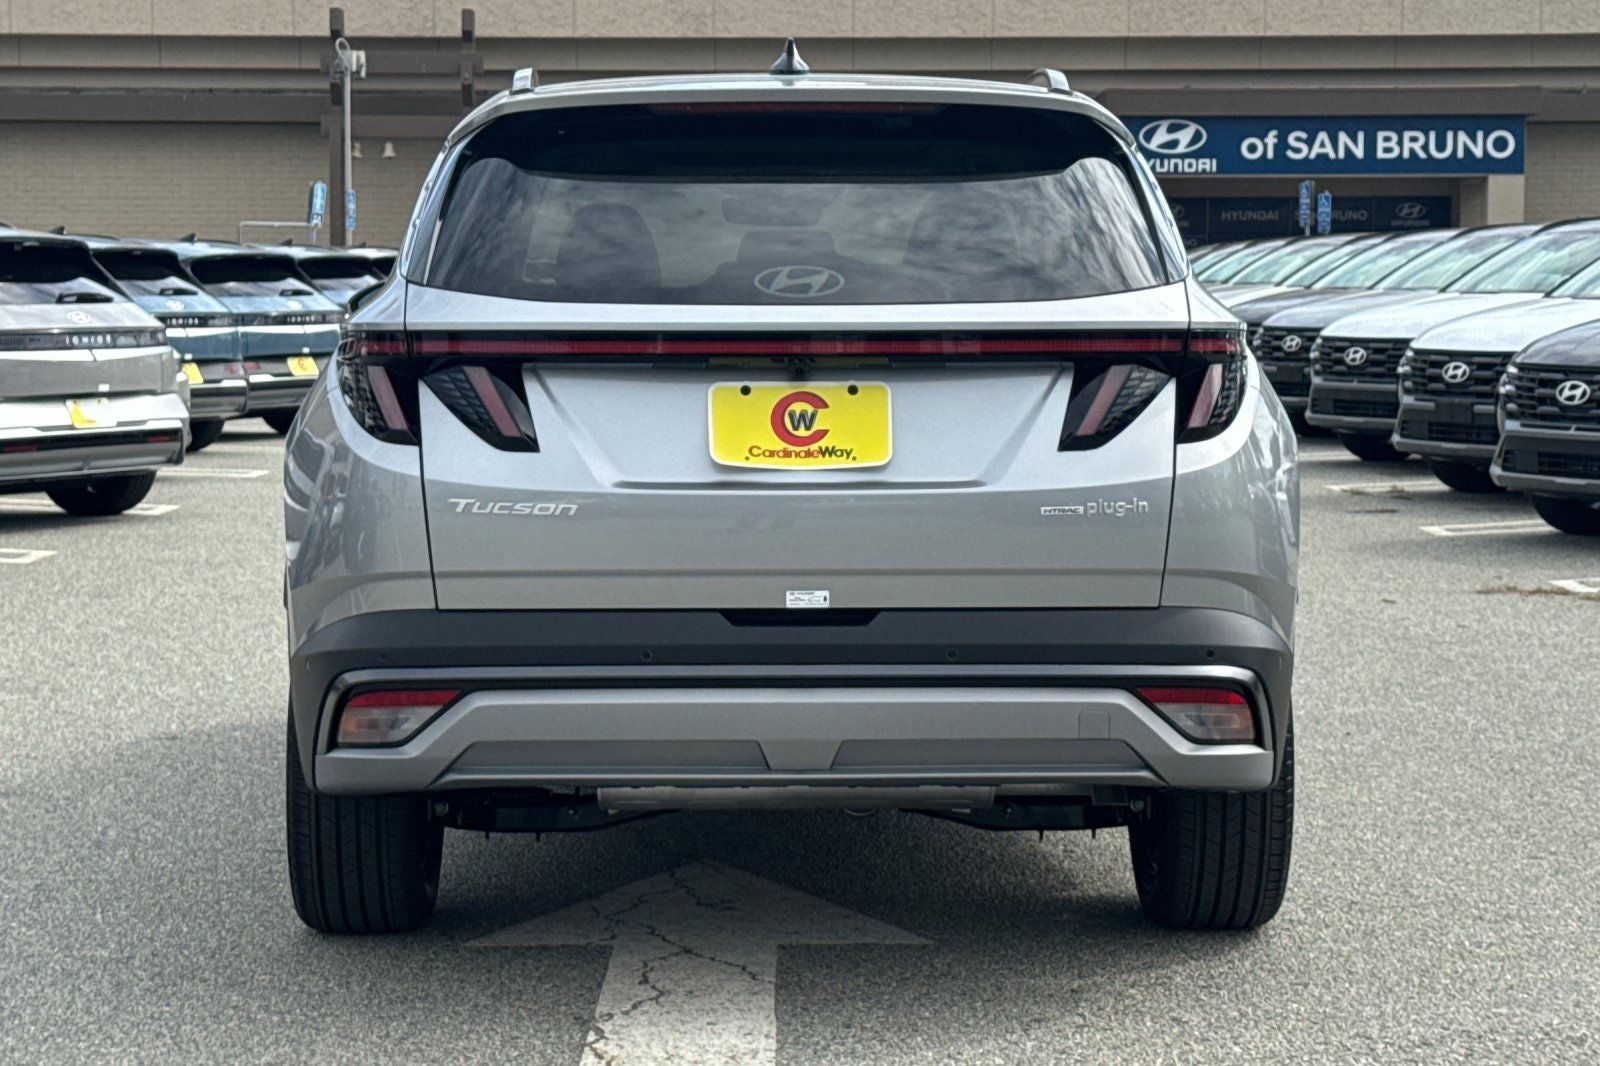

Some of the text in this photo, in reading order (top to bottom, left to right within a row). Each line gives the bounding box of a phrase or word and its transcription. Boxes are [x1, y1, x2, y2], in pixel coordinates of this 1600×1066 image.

[1240, 129, 1516, 160] of SAN BRUNO
[1148, 158, 1217, 173] UNDAI
[1221, 210, 1279, 221] HYUNDAI
[1332, 210, 1368, 221] RUNO
[748, 445, 854, 460] CardinaleWay
[1086, 497, 1149, 518] plug-in
